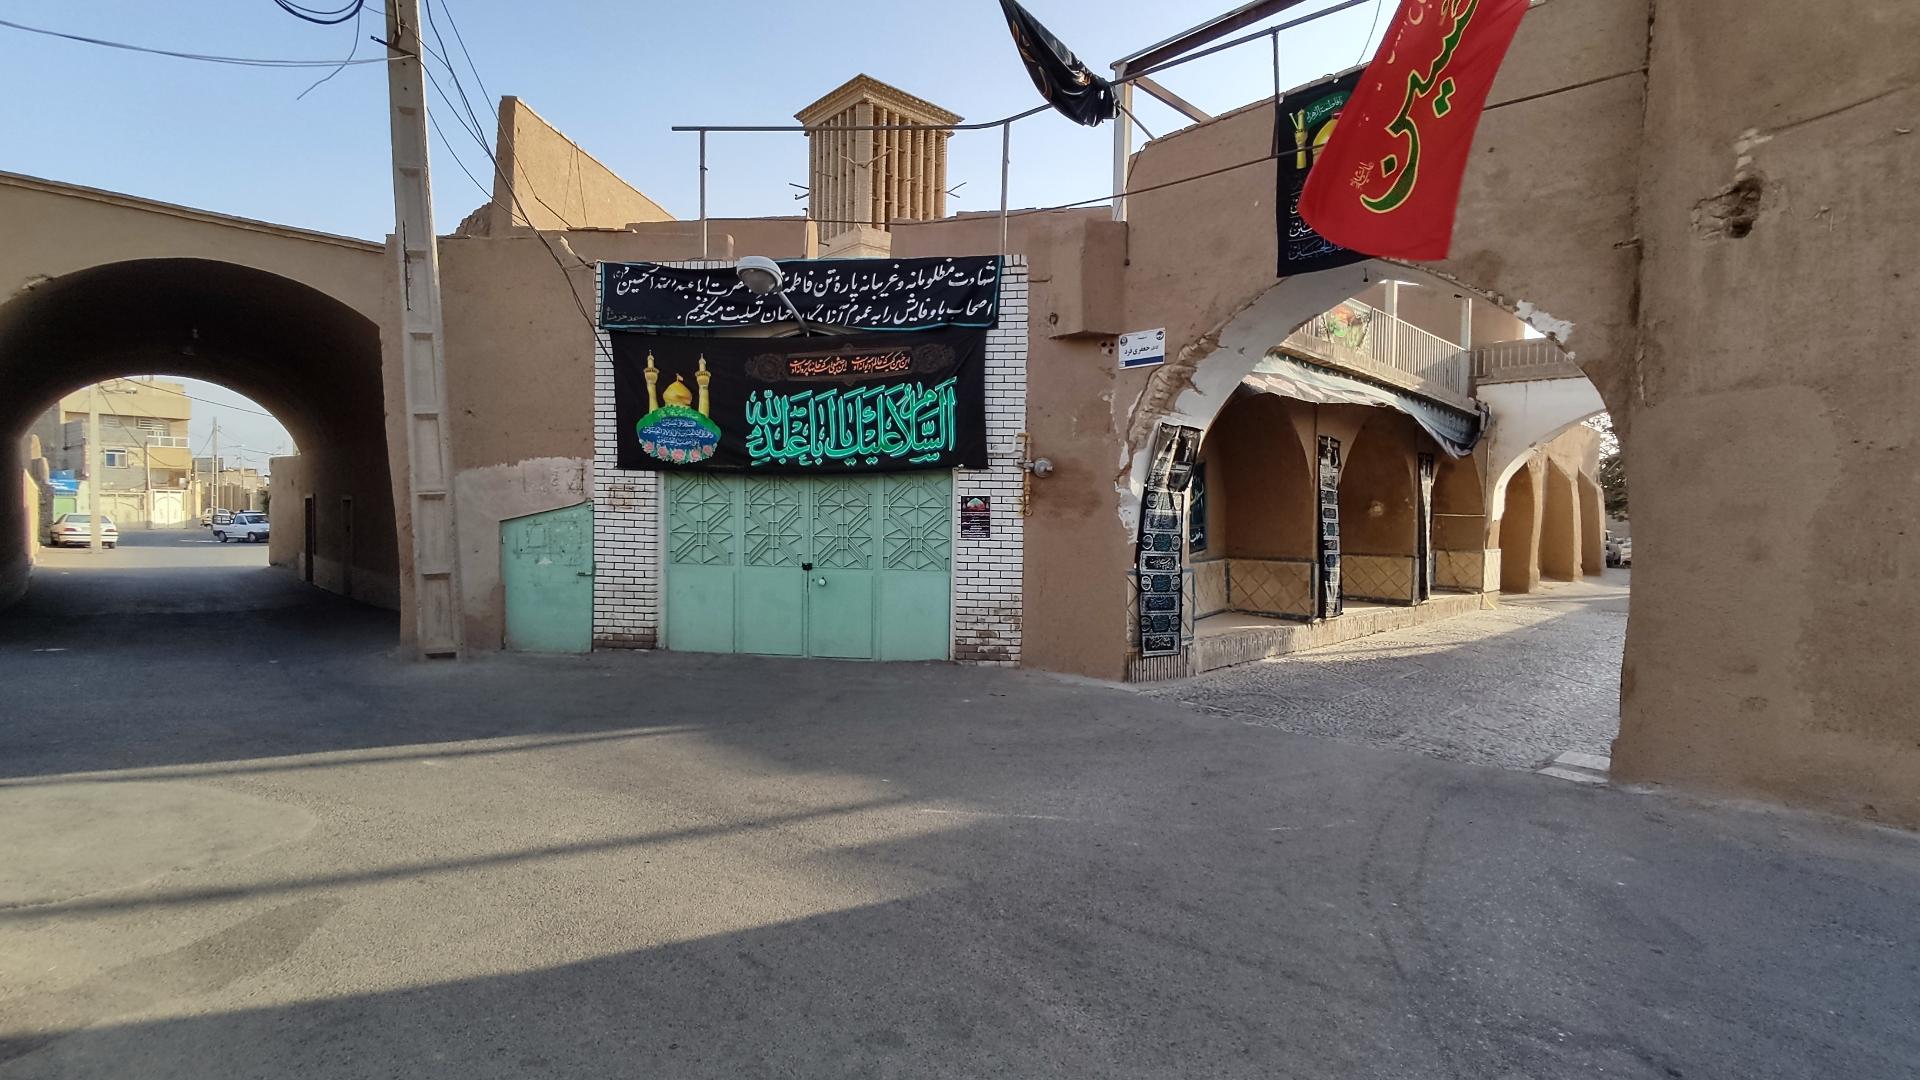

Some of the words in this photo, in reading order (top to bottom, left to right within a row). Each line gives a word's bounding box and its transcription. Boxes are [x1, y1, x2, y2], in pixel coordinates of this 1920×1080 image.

[813, 268, 837, 298] تن
[859, 263, 900, 300] غریبانه
[895, 279, 904, 291] و
[905, 257, 955, 291] مظلومانه
[948, 259, 996, 287] شهادت
[720, 299, 764, 323] تسلیت
[760, 304, 793, 324] جهان
[844, 304, 873, 328] عموم
[946, 298, 993, 321] اصحاب
